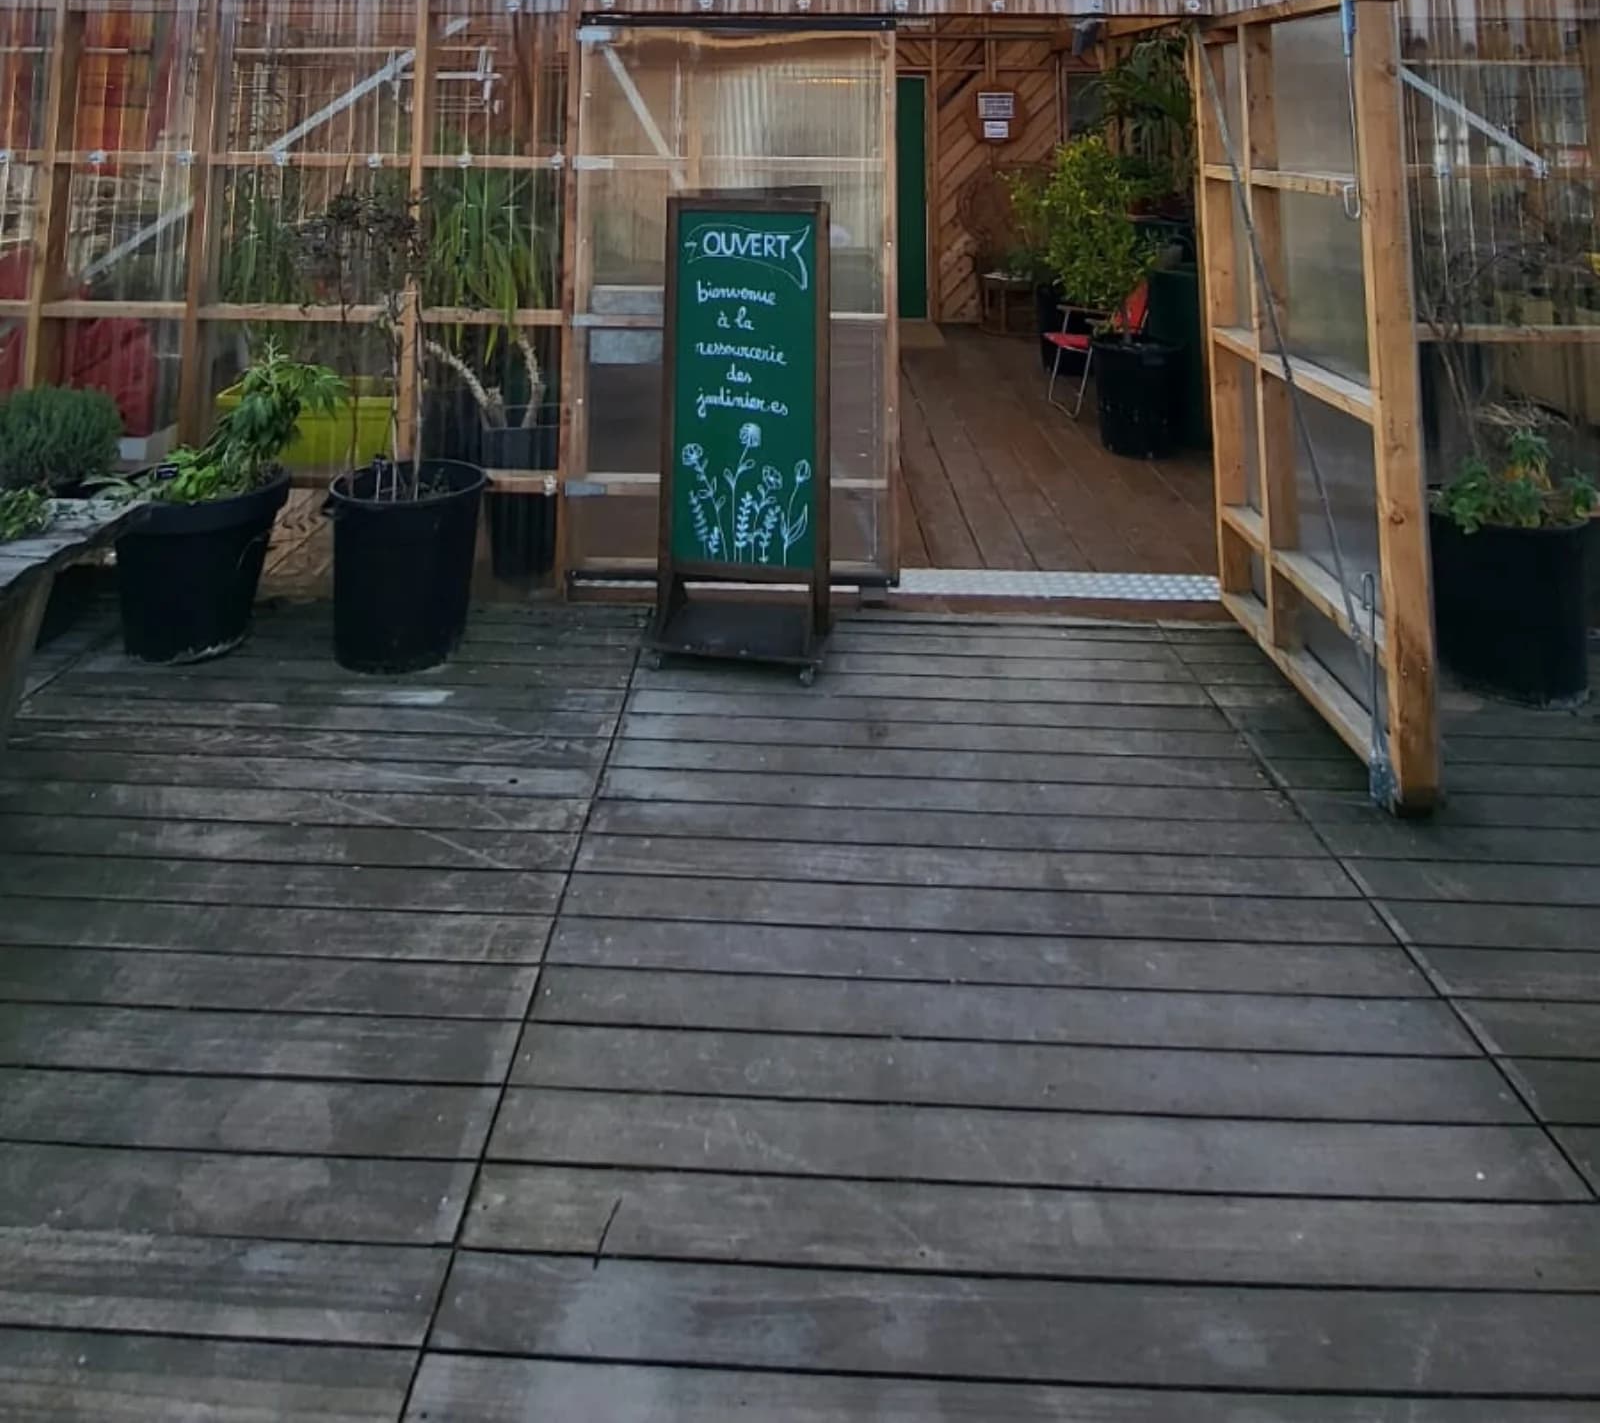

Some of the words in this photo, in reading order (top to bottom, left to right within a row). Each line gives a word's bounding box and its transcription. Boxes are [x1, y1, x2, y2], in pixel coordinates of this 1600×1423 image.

[703, 231, 791, 260] OUVERT
[734, 305, 754, 330] la
[696, 342, 787, 365] ressourcerie
[726, 363, 752, 384] des
